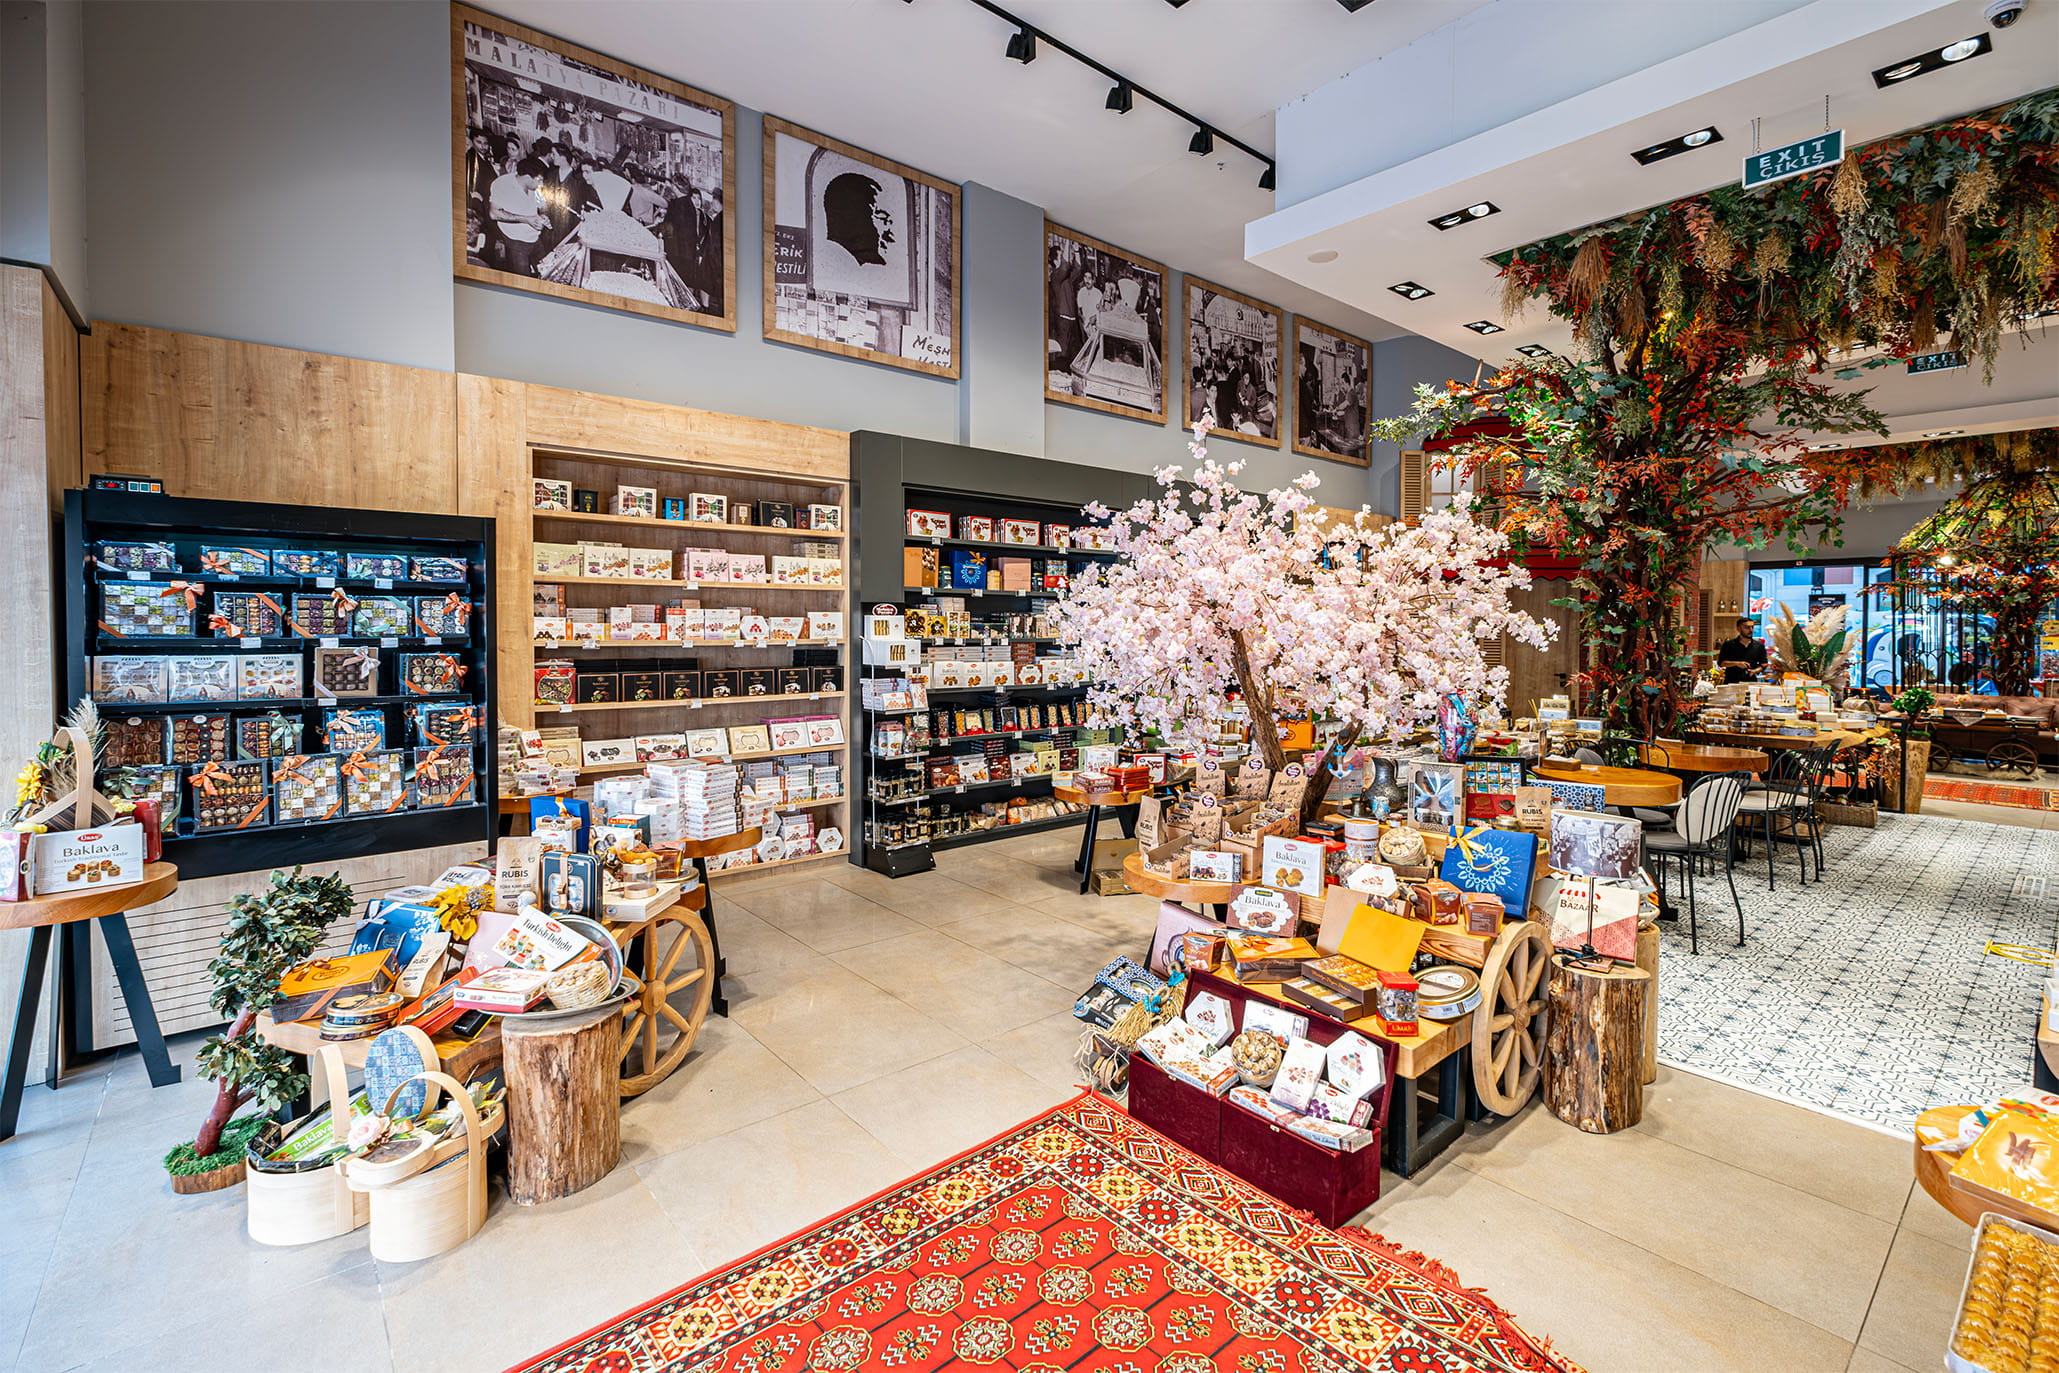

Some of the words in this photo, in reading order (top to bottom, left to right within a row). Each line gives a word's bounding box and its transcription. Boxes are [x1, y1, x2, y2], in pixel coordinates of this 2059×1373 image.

[466, 37, 584, 89] MALATYA
[600, 82, 679, 119] PAZARI
[1759, 139, 1826, 169] EXIT
[1760, 151, 1825, 179] ÇIKIŞ
[775, 262, 806, 275] ESTİLİ
[63, 843, 120, 857] Baklava
[1275, 851, 1307, 865] Baklava
[502, 869, 529, 878] RUBIS
[1244, 895, 1281, 909] Baklava
[522, 918, 548, 939] Turkish
[546, 931, 574, 953] Delight
[292, 1123, 333, 1151] Baklava
